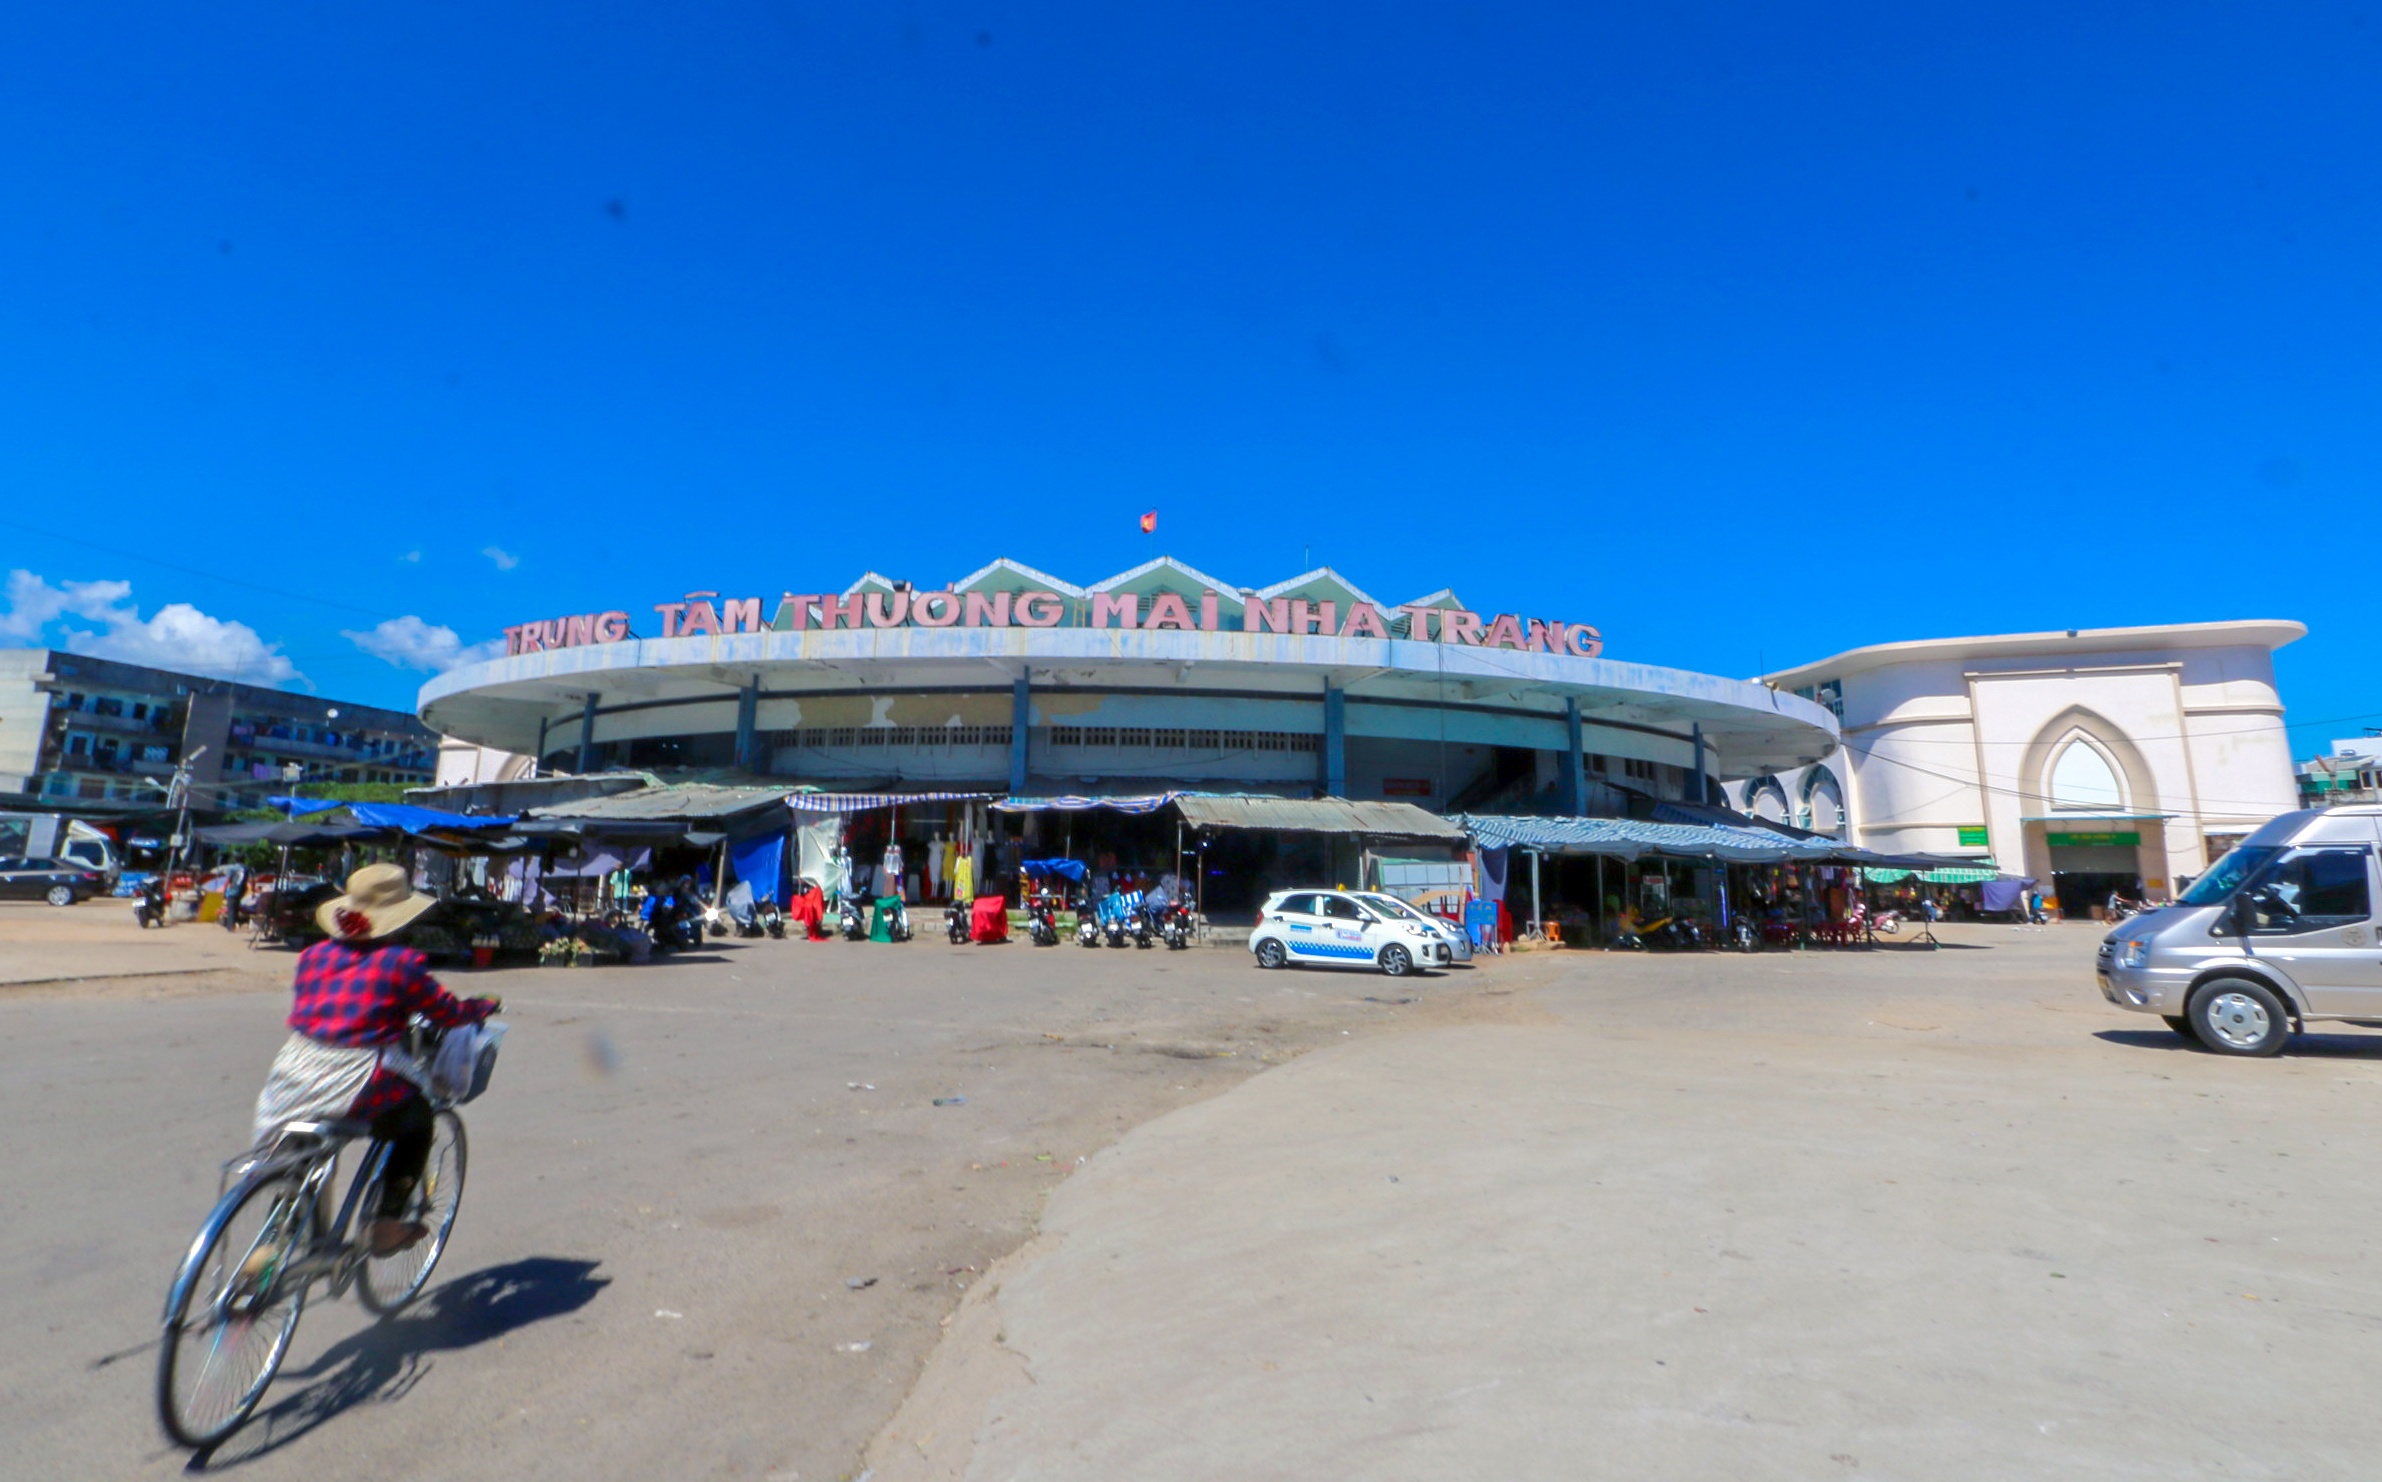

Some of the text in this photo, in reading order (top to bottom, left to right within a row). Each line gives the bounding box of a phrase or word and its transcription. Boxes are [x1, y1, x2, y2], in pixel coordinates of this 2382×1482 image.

[503, 611, 630, 656] TRUNG
[1243, 597, 1388, 638] NHA
[1400, 605, 1604, 658] TRANG
